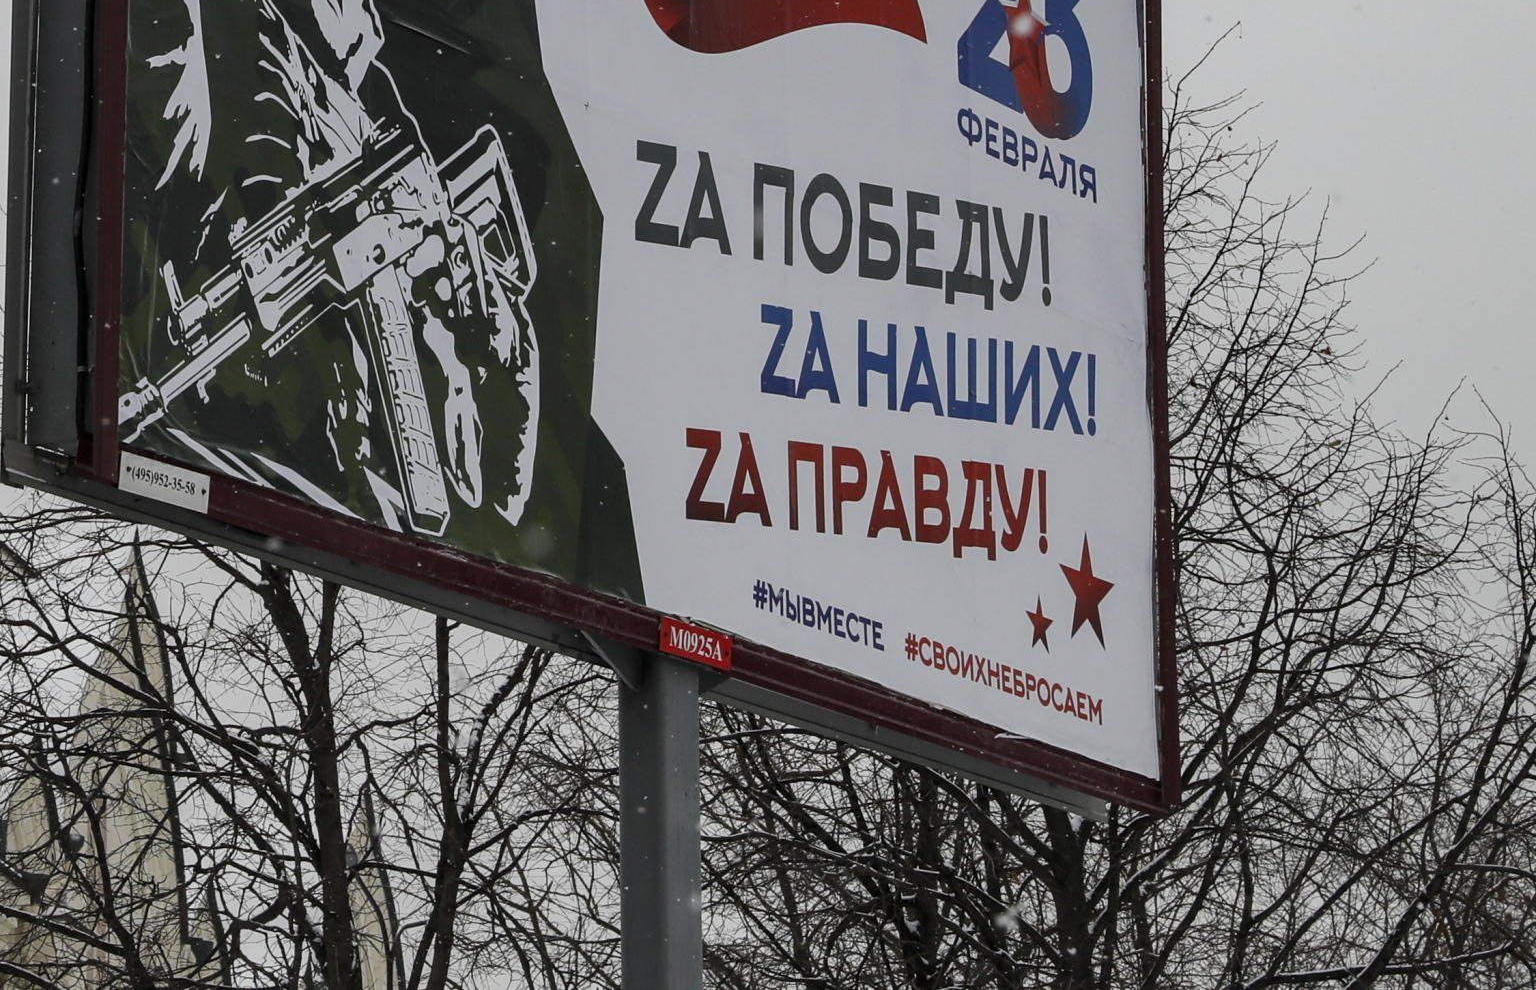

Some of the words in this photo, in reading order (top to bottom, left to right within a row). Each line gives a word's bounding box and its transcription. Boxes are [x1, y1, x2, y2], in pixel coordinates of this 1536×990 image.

[957, 108, 1098, 204] ФЕВРАЛЯ
[753, 162, 1052, 310] ПОБЕДУ!
[857, 318, 1097, 437] НАШИХ!
[131, 465, 196, 495] (495)952-35-58
[787, 440, 1048, 561] ПРАВДУ!
[669, 625, 723, 662] M0925A
[752, 579, 885, 651] #МЫВМЕСТЕ
[904, 631, 1103, 726] #СВОИХНЕБРОСАЕМ
